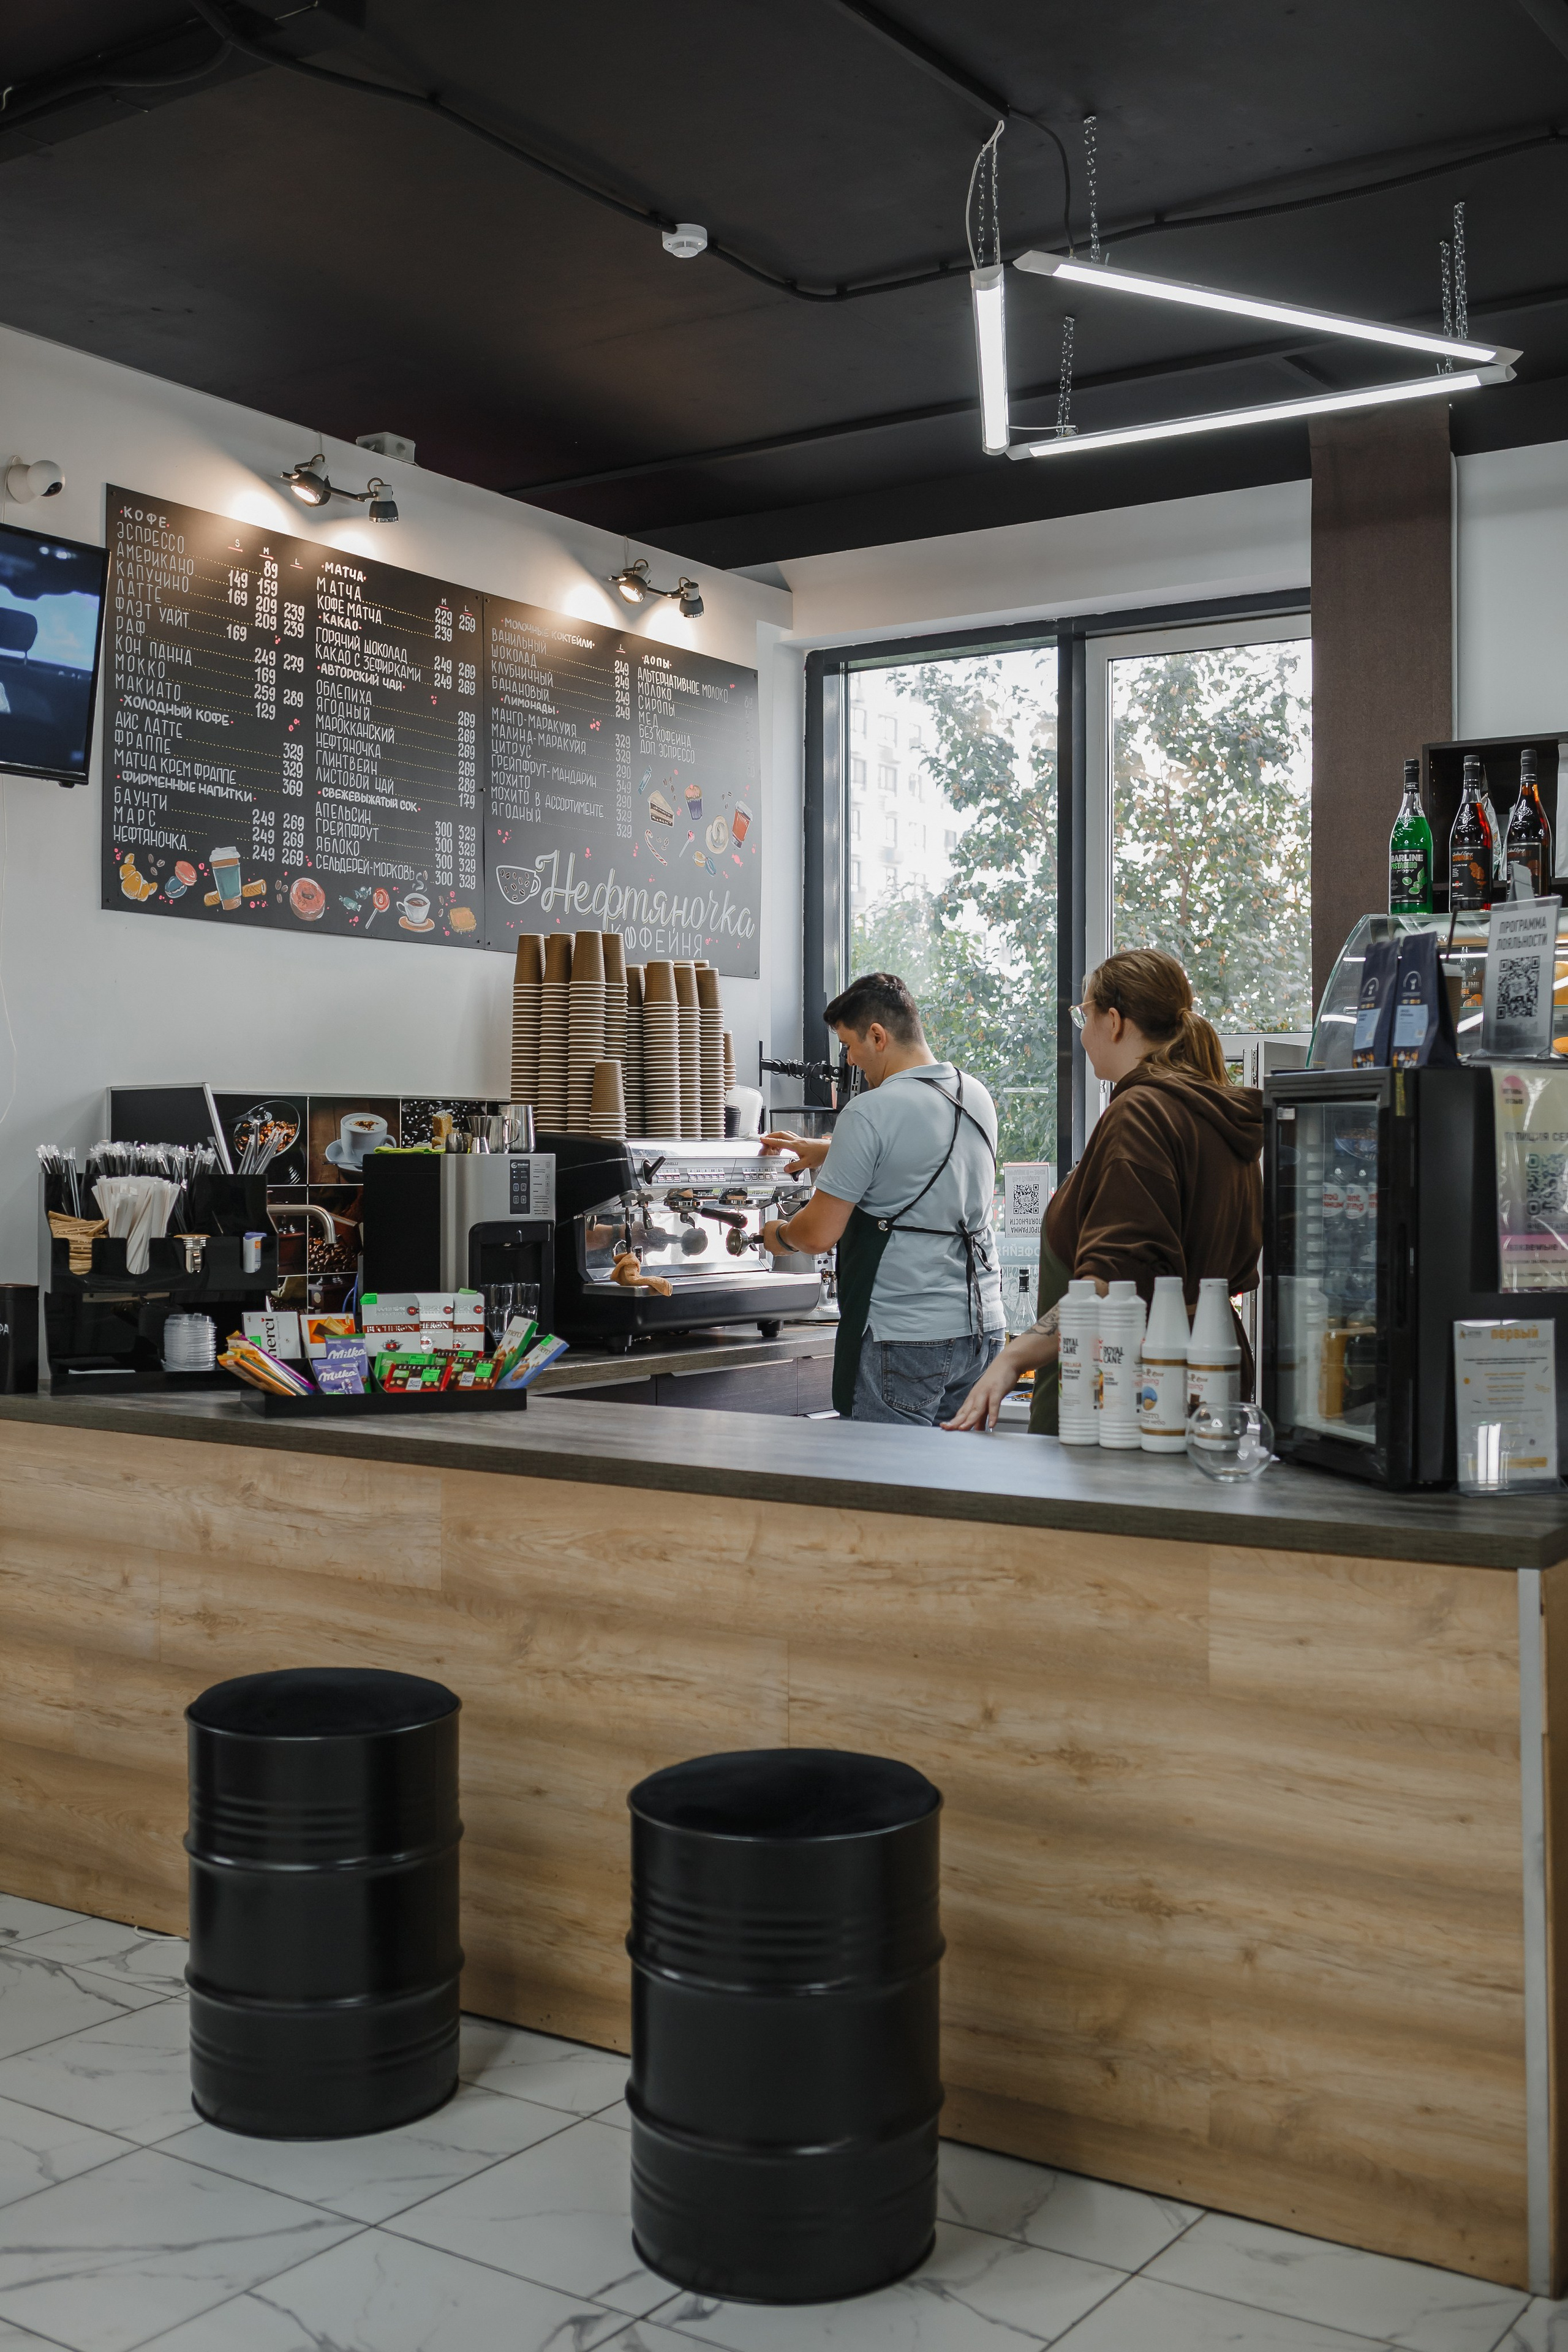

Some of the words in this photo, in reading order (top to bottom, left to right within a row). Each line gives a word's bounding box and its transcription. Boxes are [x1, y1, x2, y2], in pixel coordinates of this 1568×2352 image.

[123, 506, 167, 528] КОФЕ
[116, 541, 194, 575] АМЕРИКАНО
[228, 570, 248, 589] 149
[257, 578, 278, 597] 159
[117, 521, 184, 553] ЭСПРЕССО
[264, 560, 278, 578] 89
[116, 560, 189, 592] КАПУЧИНО
[227, 589, 247, 606] 169
[255, 596, 277, 614] 209
[284, 603, 304, 622] 239
[325, 562, 364, 582] МАТЧА
[116, 597, 152, 619] ФЛЭТ
[159, 607, 189, 628] УАЙТ
[227, 624, 247, 642] 169
[117, 579, 161, 603] ЛАТТЕ
[255, 612, 277, 630] 209
[284, 620, 304, 638] 239
[317, 576, 361, 601] МАТЧА
[435, 608, 452, 626] 229
[459, 614, 475, 632] 259
[317, 594, 344, 612] КОФЕ
[347, 603, 382, 624] МАТЧА
[435, 625, 452, 642] 239
[323, 612, 358, 631] КАКАО
[116, 616, 145, 636] РАФ
[255, 647, 276, 666] 249
[284, 654, 304, 673] 279
[316, 627, 360, 651] ГОРЯЧИЙ
[364, 640, 407, 664] ШОКОЛАД
[434, 656, 452, 673] 249
[459, 663, 475, 679] 269
[492, 628, 546, 655] ВАНИЛЬНЫЙ
[615, 660, 628, 674] 249
[505, 618, 549, 637] МОЛОЧНЫЕ
[552, 632, 592, 649] КОКТЕЙЛИ
[116, 635, 141, 655] КОН
[150, 642, 192, 666] ПАННА
[255, 667, 276, 685] 169
[116, 654, 165, 678] МОККО
[254, 684, 276, 701] 259
[284, 689, 303, 707] 289
[316, 644, 350, 664] КАКАО
[364, 656, 421, 682] ЗЕФИРКАМИ
[434, 673, 452, 690] 249
[458, 679, 475, 695] 269
[321, 663, 379, 686] АВТОРСКИЙ
[383, 677, 402, 692] ЧАЙ
[492, 644, 537, 668] ШОКОЛАД
[616, 676, 629, 690] 249
[644, 655, 669, 669] ДОПЫ
[116, 674, 180, 701] МАКИАТО
[255, 703, 275, 720] 129
[492, 660, 553, 687] КЛУБНИЧНЫЙ
[616, 690, 630, 705] 249
[492, 676, 549, 702] БАНАНОВЫЙ
[616, 705, 630, 720] 249
[638, 667, 699, 695] АЛЬТЕРНАТИВНОЕ
[702, 684, 728, 703] МОЛОКО
[638, 681, 671, 701] МОЛОКО
[123, 695, 192, 718] ХОЛОДНЫЙ
[196, 710, 230, 726] КОФЕ
[317, 680, 372, 705] ОБЛЕПИХА
[458, 711, 475, 728] 269
[317, 697, 370, 722] ЯГОДНЫЙ
[458, 728, 475, 744] 269
[504, 695, 555, 714] ЛИМОНАДЫ
[638, 695, 675, 717] СИРОПЫ
[639, 712, 658, 728] МЕД
[116, 711, 138, 729] АЙС
[145, 717, 183, 738] ЛАТТЕ
[283, 742, 303, 761] 329
[316, 714, 394, 744] МАРОККАНСКИЙ
[458, 743, 475, 760] 269
[492, 707, 576, 737] МАНГО-МАРАКУЙЯ
[616, 734, 630, 748] 329
[492, 723, 586, 755] МАЛИНА-МАРАКУЙЯ
[616, 749, 631, 764] 329
[639, 725, 653, 739] БЕЗ
[657, 728, 692, 748] КОФЕИНА
[115, 729, 171, 754] ФРАППЕ
[283, 761, 303, 778] 329
[316, 732, 381, 759] НЕФТЯНОЧКА
[459, 761, 475, 777] 269
[316, 750, 377, 775] ГЛИНТВЕЙН
[459, 777, 475, 793] 289
[492, 739, 531, 758] ЦИТРУС
[616, 764, 631, 779] 290
[640, 739, 656, 755] ДОП
[660, 743, 695, 764] ЭСПРЕССО
[115, 749, 156, 771] МАТЧА
[161, 758, 190, 776] КРЕМ
[194, 764, 236, 784] ФРАППЕ
[282, 780, 303, 797] 369
[123, 771, 195, 793] ФИРМЕННЫЕ
[198, 783, 252, 802] НАПИТКИ
[316, 767, 369, 790] ЛИСТОВОЙ
[375, 777, 394, 795] ЧАЙ
[459, 793, 475, 809] 179
[491, 755, 596, 788] ГРЕЙПФРУТ-МАНДАРИН
[616, 779, 631, 794] 349
[491, 771, 530, 790] МОХИТО
[616, 794, 631, 809] 290
[115, 786, 167, 811] БАУНТИ
[252, 809, 274, 826] 249
[283, 813, 304, 831] 269
[322, 788, 398, 809] СВЕЖЕВЫЖАТЫЙ
[400, 801, 417, 812] СОК
[491, 786, 529, 805] МОХИТО
[545, 795, 604, 818] АССОРТИМЕНТЕ
[616, 809, 631, 823] 329
[492, 802, 541, 823] ЯГОДНЫЙ
[617, 824, 632, 838] 329
[115, 806, 156, 827] МАРС
[252, 827, 274, 844] 249
[283, 831, 304, 848] 269
[316, 802, 371, 824] АПЕЛЬСИН
[435, 821, 452, 837] 300
[459, 826, 475, 841] 329
[316, 818, 379, 842] ГРЕЙПФРУТ
[435, 837, 452, 853] 300
[459, 842, 475, 856] 329
[114, 825, 187, 850] НЕФТЯНОЧКА
[252, 845, 274, 862] 249
[282, 850, 303, 866] 269
[316, 837, 360, 856] ЯБЛОКО
[435, 854, 452, 870] 300
[459, 859, 475, 873] 329
[316, 854, 414, 881] СЕЛЬДЕРЕЙ-МОРКОВЬ
[435, 871, 452, 886] 300
[459, 875, 475, 889] 329
[535, 850, 756, 939] Нефтяночка
[1496, 933, 1548, 951] ЛОЯЛЬНОСТИ
[1499, 917, 1547, 933] ПРОГРАММА
[328, 1347, 366, 1359] Milka
[318, 1370, 357, 1382] Milka
